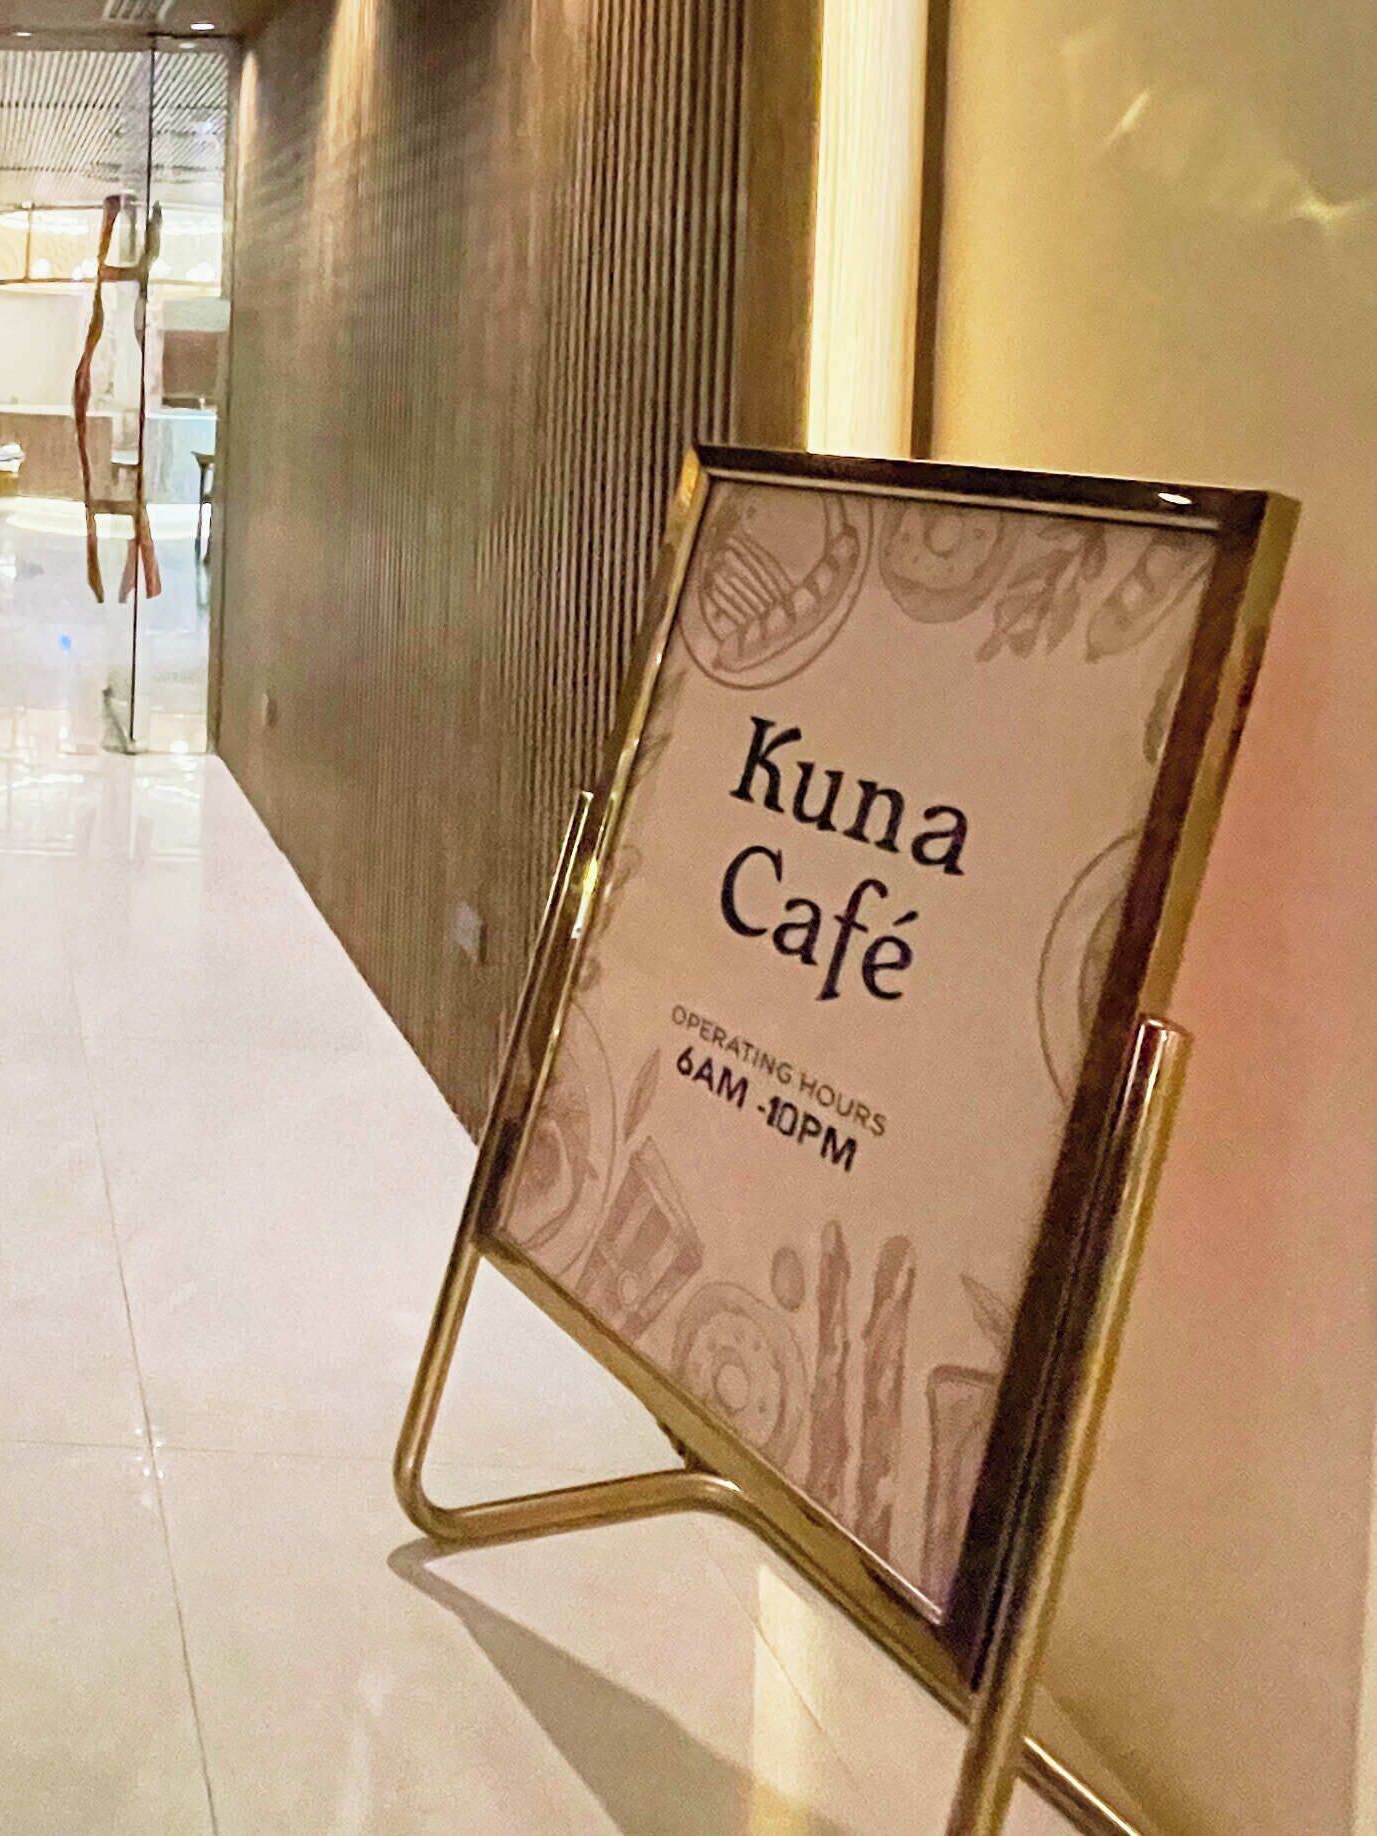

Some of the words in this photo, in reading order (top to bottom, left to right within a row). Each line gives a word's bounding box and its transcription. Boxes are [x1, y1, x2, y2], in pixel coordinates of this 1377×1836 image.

[729, 716, 968, 875] Kuna
[721, 845, 918, 1001] Café
[672, 1005, 793, 1084] OPERATING
[798, 1072, 887, 1136] HOURS
[676, 1046, 749, 1109] 6AM
